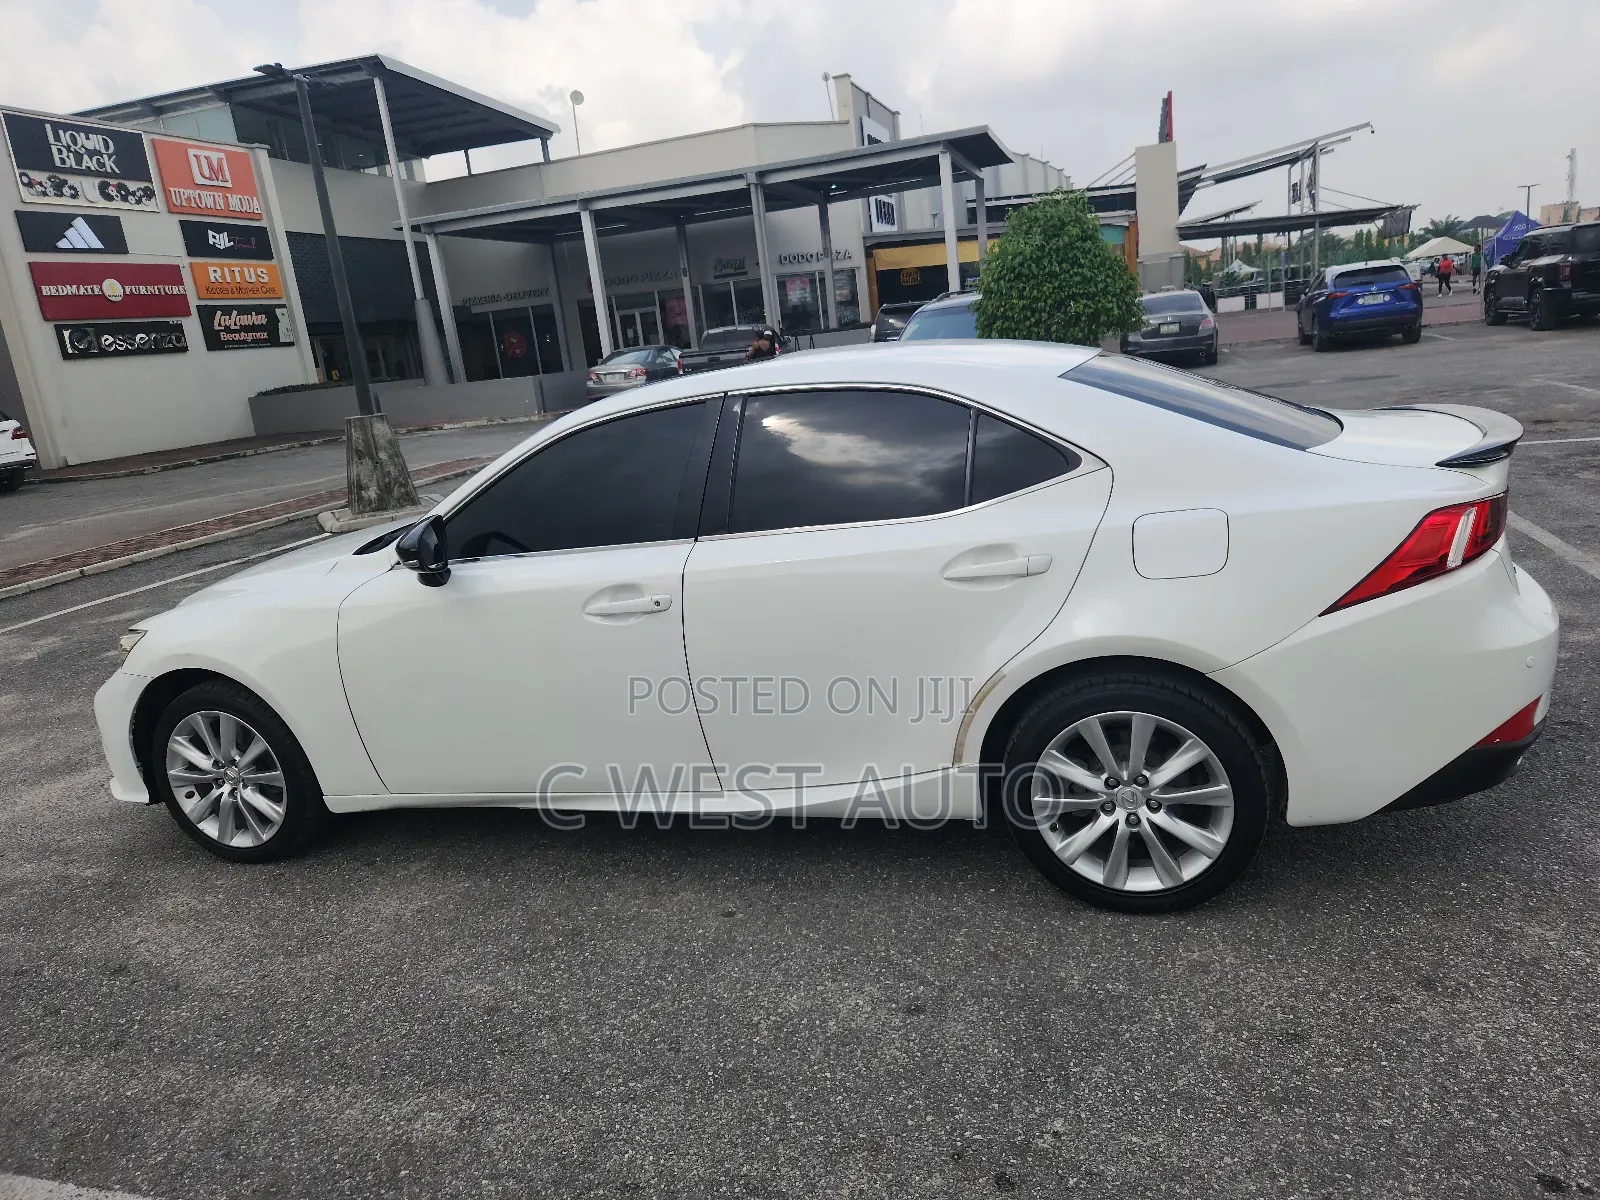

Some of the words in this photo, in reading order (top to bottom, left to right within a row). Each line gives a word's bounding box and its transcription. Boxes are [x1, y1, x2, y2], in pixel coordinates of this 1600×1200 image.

[45, 124, 114, 154] LIQUID
[50, 144, 120, 174] BLACK
[168, 187, 225, 210] UPTOWN
[226, 193, 262, 214] MODA
[780, 252, 814, 265] DODO
[816, 249, 852, 262] PZA
[208, 266, 269, 283] RITUS
[40, 284, 103, 296] BEDMATE
[124, 284, 187, 296] FURNITURE
[101, 332, 187, 352] essenza
[220, 331, 269, 342] Beautymax
